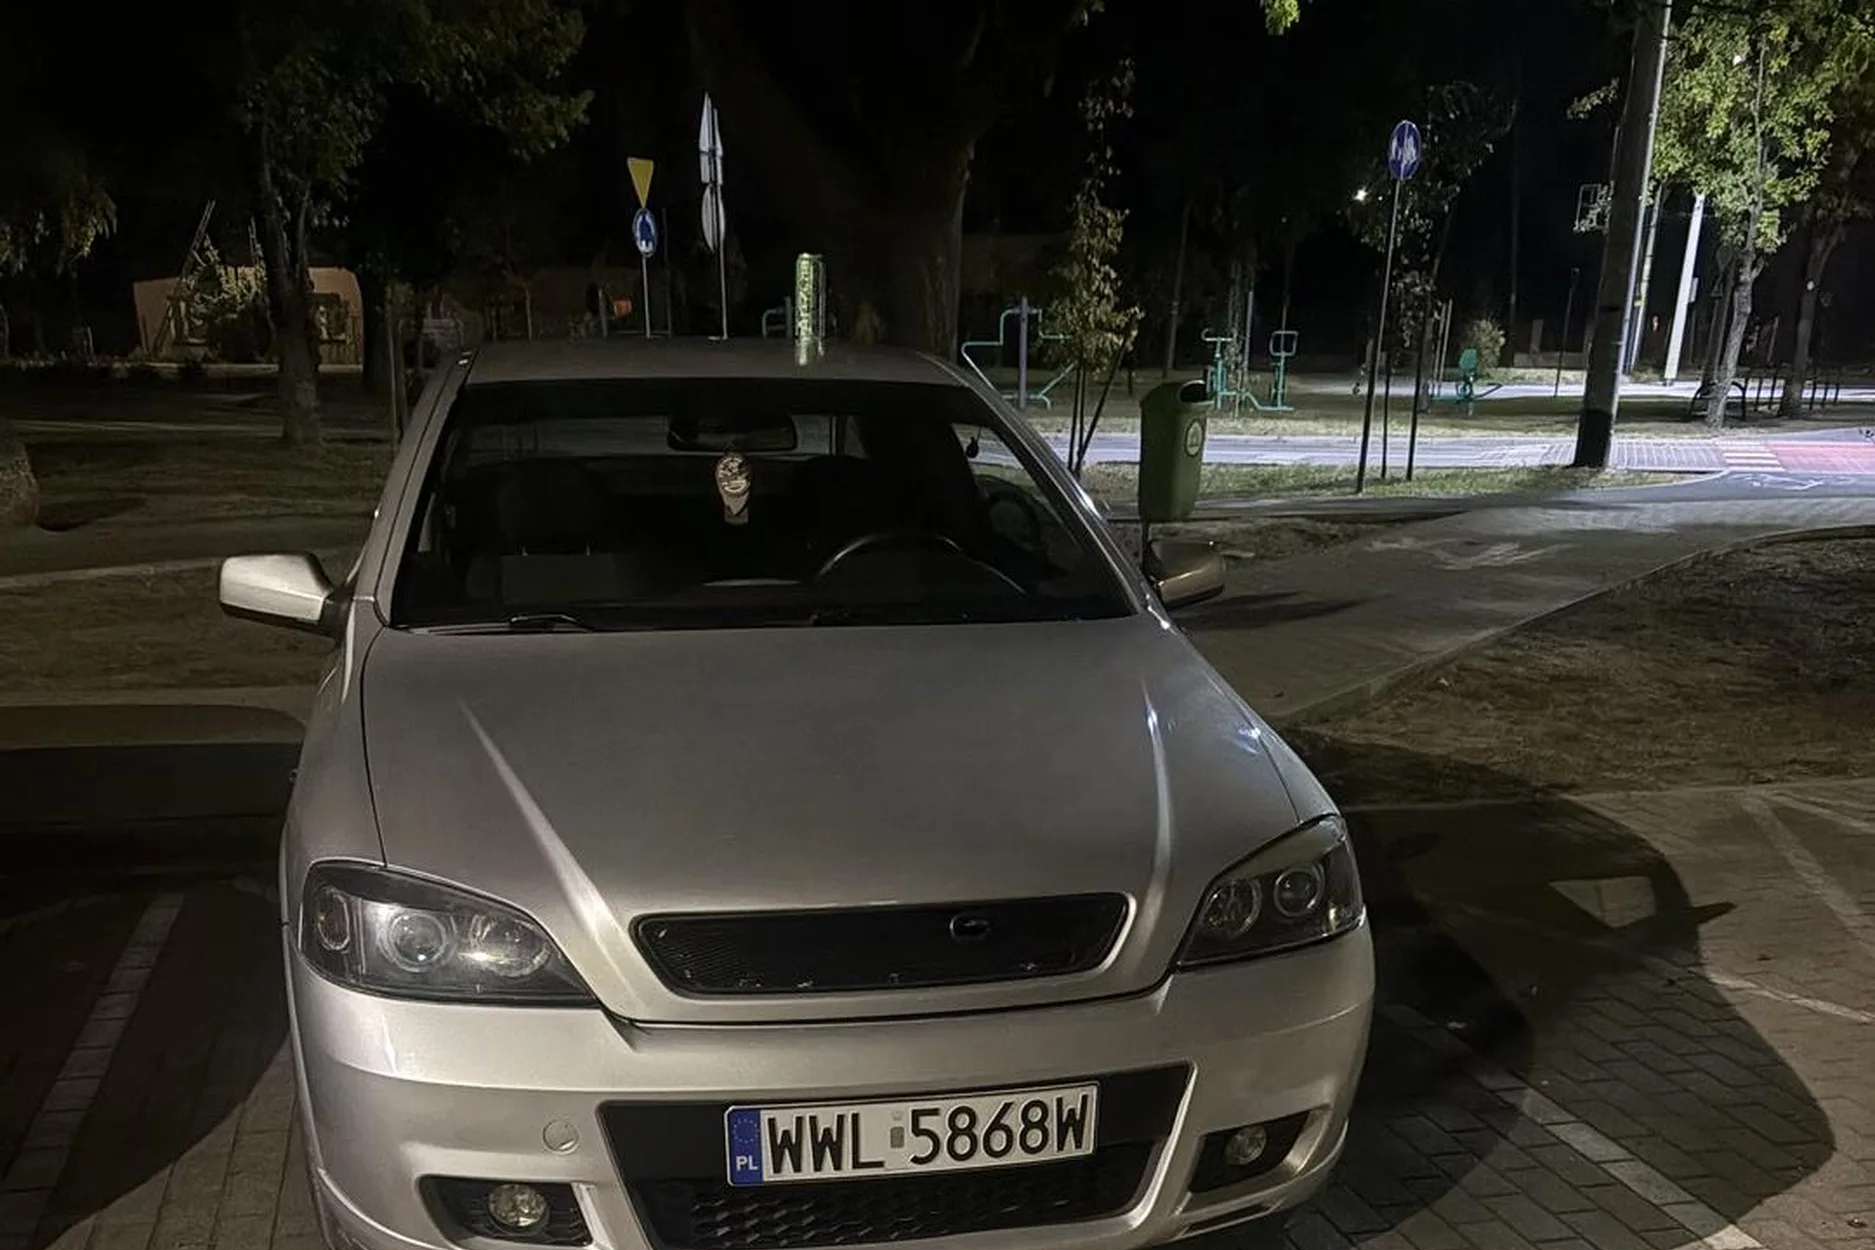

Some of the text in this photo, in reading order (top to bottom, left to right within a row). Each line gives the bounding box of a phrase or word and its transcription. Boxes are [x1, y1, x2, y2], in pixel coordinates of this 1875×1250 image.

[767, 1094, 1089, 1174] WWL 5868W
[735, 1156, 759, 1171] PL
